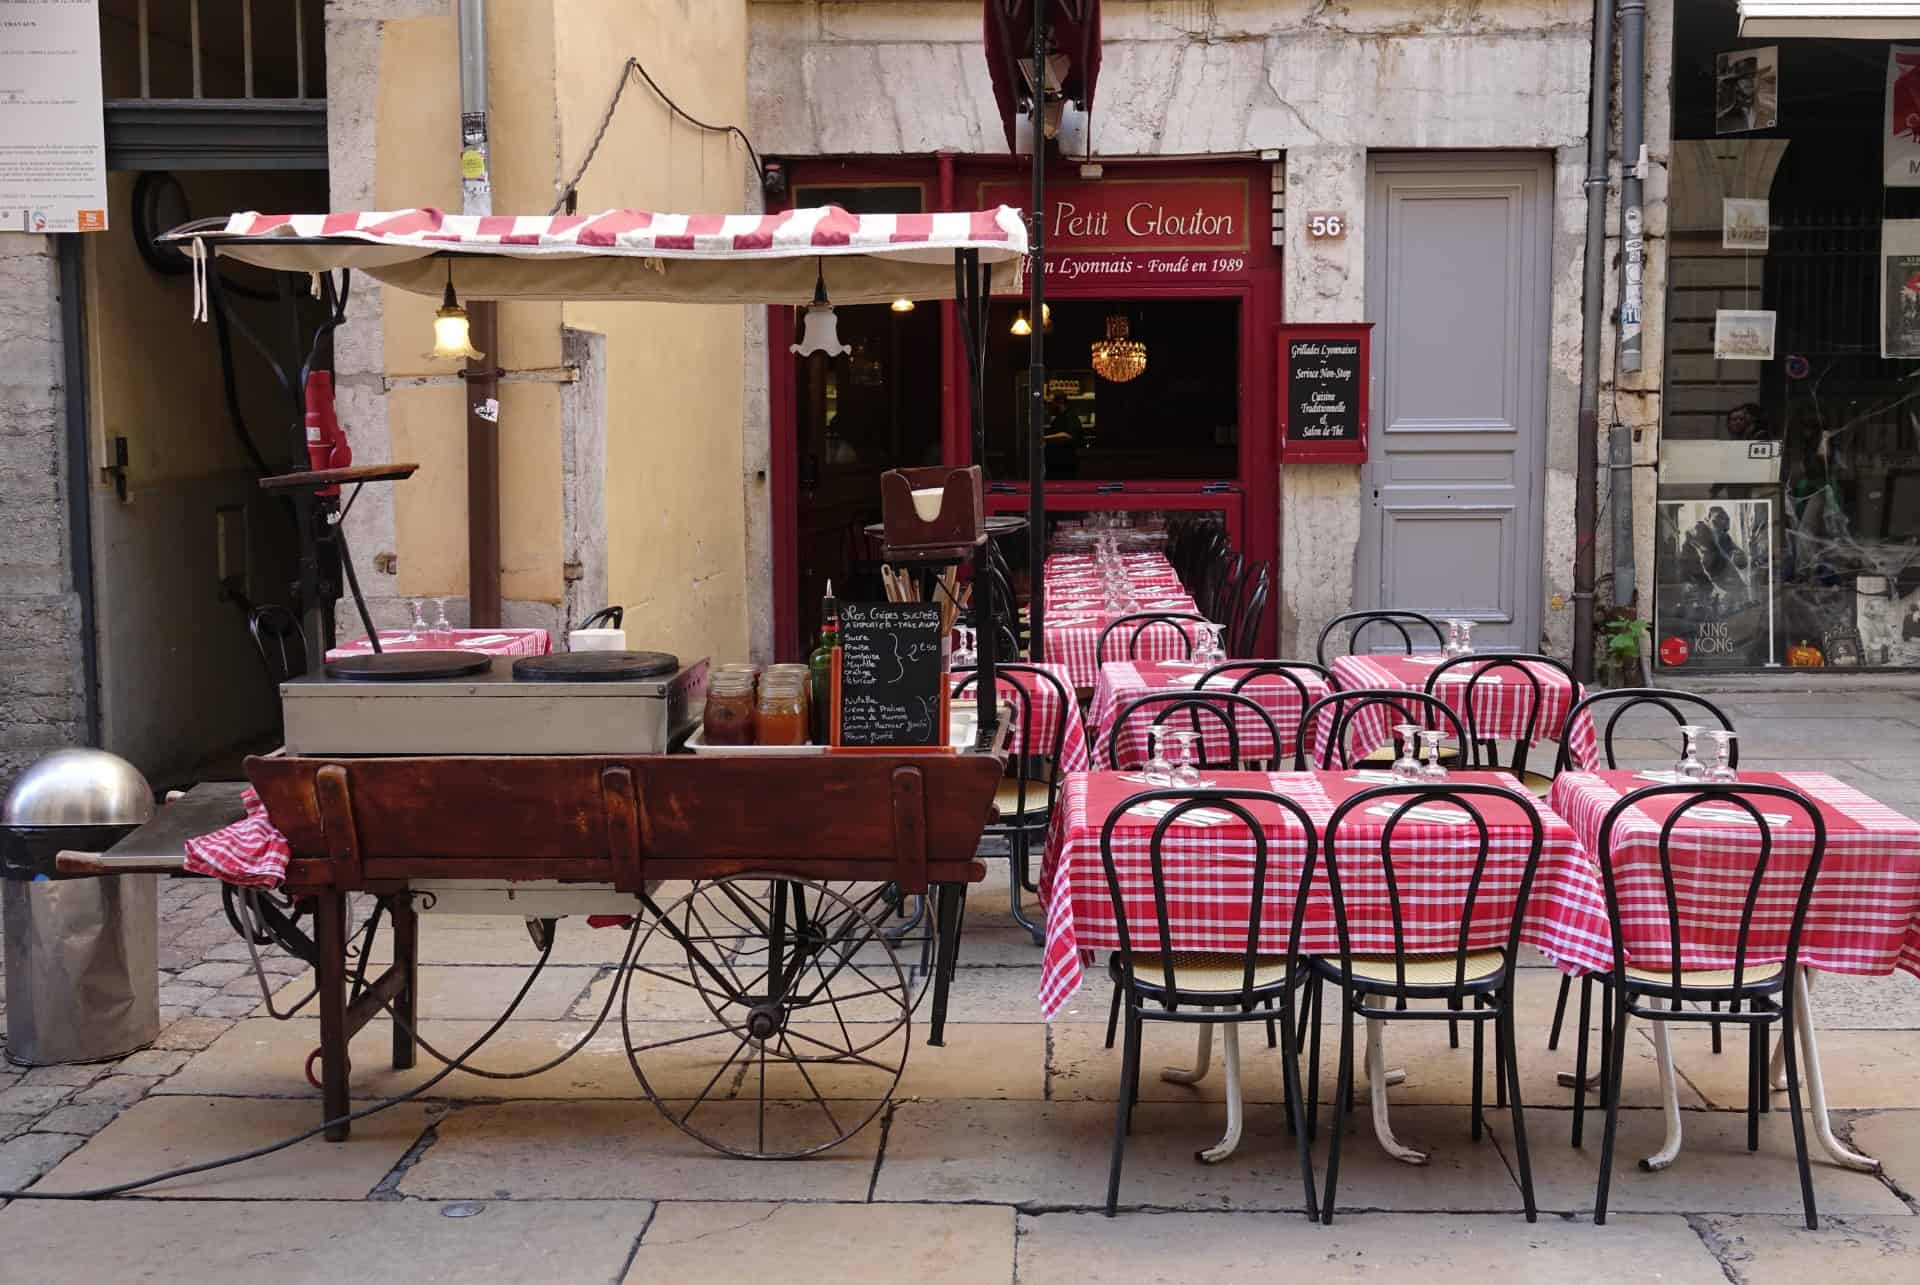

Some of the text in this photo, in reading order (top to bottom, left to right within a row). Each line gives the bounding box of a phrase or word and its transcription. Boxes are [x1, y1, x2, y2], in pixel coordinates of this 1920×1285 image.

[1054, 202, 1109, 236] Petit
[1126, 202, 1233, 236] Glouton
[1312, 216, 1340, 236] 56
[1058, 256, 1133, 278] Lyonnais
[1148, 256, 1189, 273] Fondé
[1192, 260, 1207, 273] en
[1212, 257, 1244, 272] 1989
[1291, 344, 1357, 358] Grillades Lyonnaises
[1296, 367, 1352, 381] Service Non-Stop
[1311, 391, 1336, 402] Cuisine
[1302, 425, 1345, 437] Salon de Thé
[1700, 623, 1728, 637] KING
[1696, 637, 1734, 653] KONG
